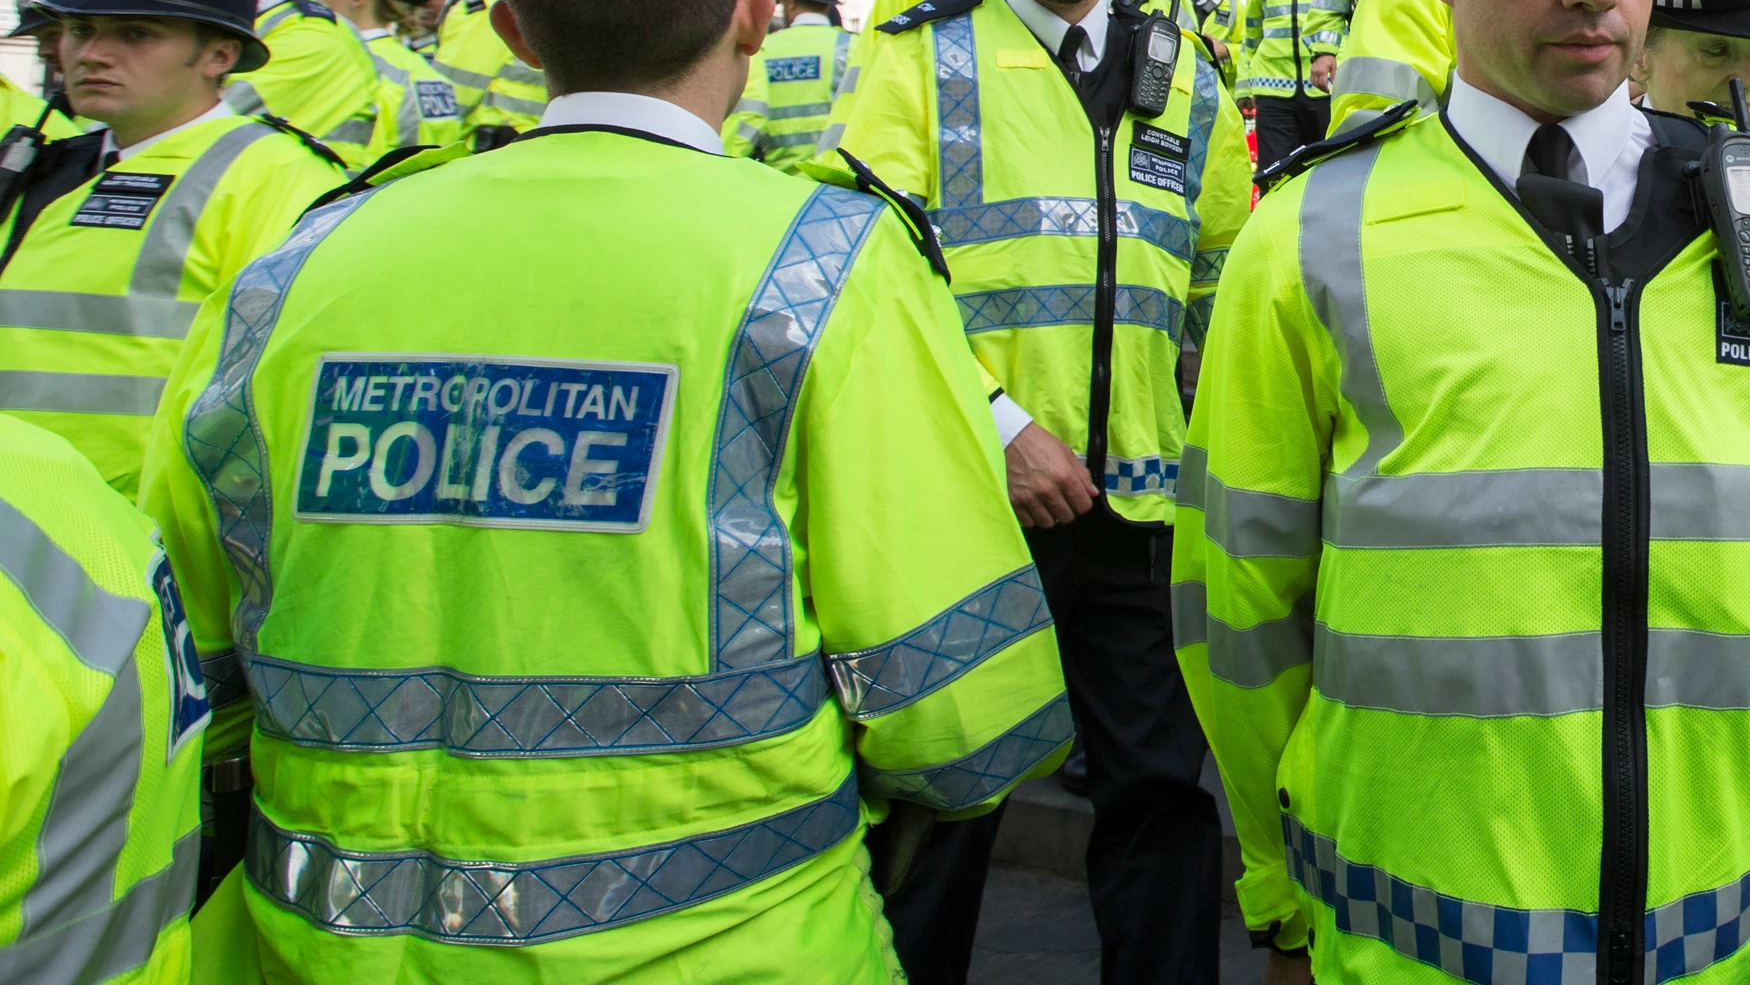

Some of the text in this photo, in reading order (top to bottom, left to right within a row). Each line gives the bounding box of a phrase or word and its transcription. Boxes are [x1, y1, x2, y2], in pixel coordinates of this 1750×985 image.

[1141, 134, 1160, 144] LEIGH
[1146, 129, 1180, 146] CONSTABLE
[1155, 165, 1178, 176] POLICE
[1131, 170, 1184, 194] POLICE OFFICER
[331, 375, 639, 421] METROPOLITAN
[316, 421, 628, 506] POLICE
